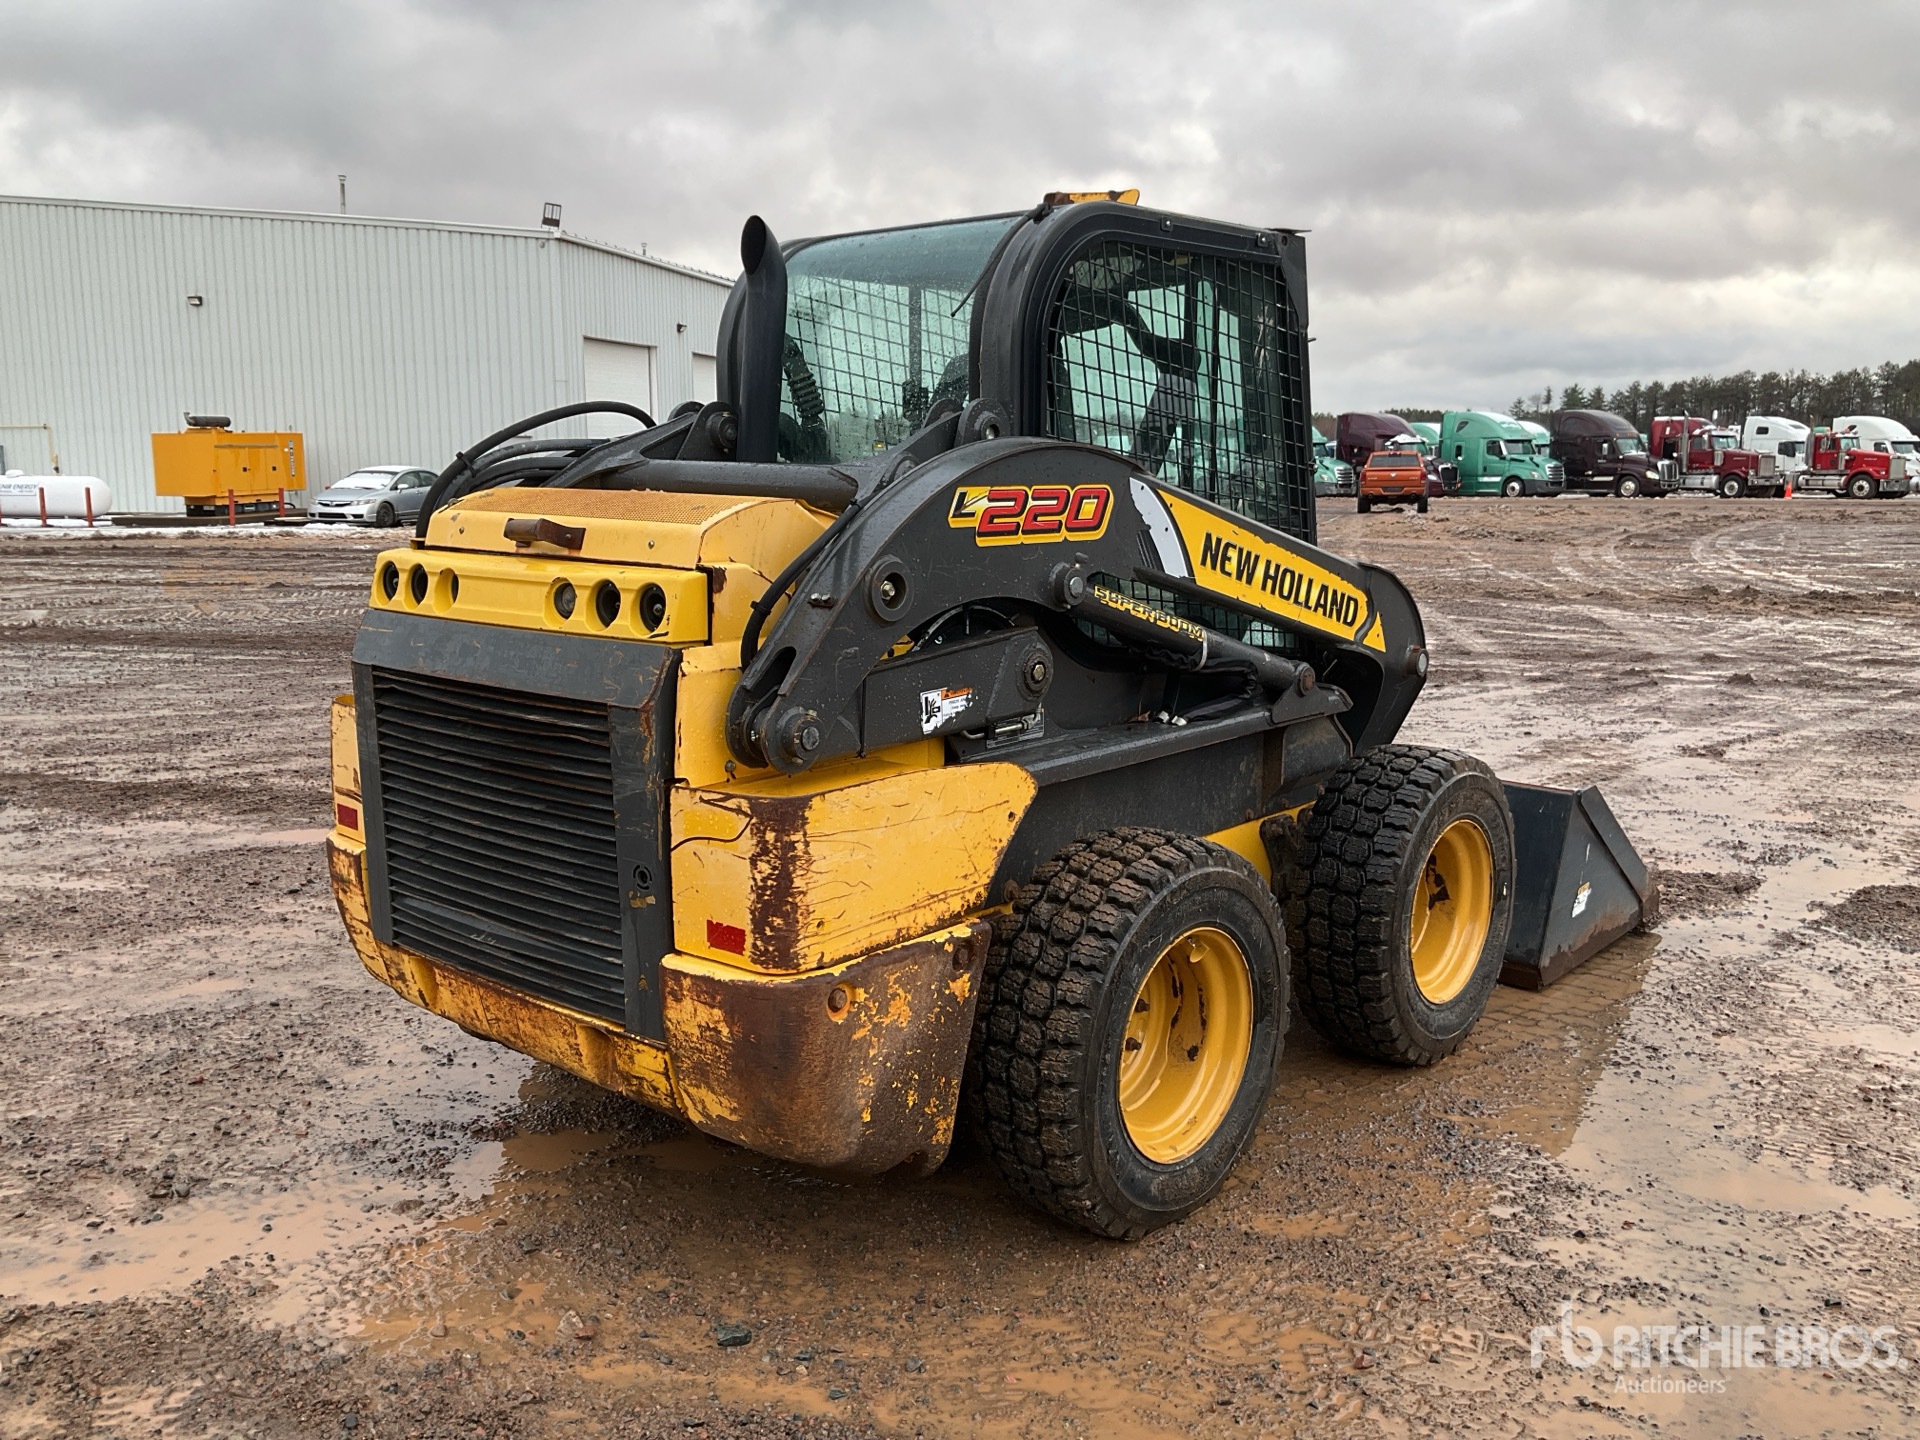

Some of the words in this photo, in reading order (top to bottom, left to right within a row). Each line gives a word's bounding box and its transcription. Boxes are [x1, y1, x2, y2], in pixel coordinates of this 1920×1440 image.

[949, 486, 1113, 543] L220
[1200, 531, 1260, 586] NEW
[1261, 558, 1359, 627] HOLLAND
